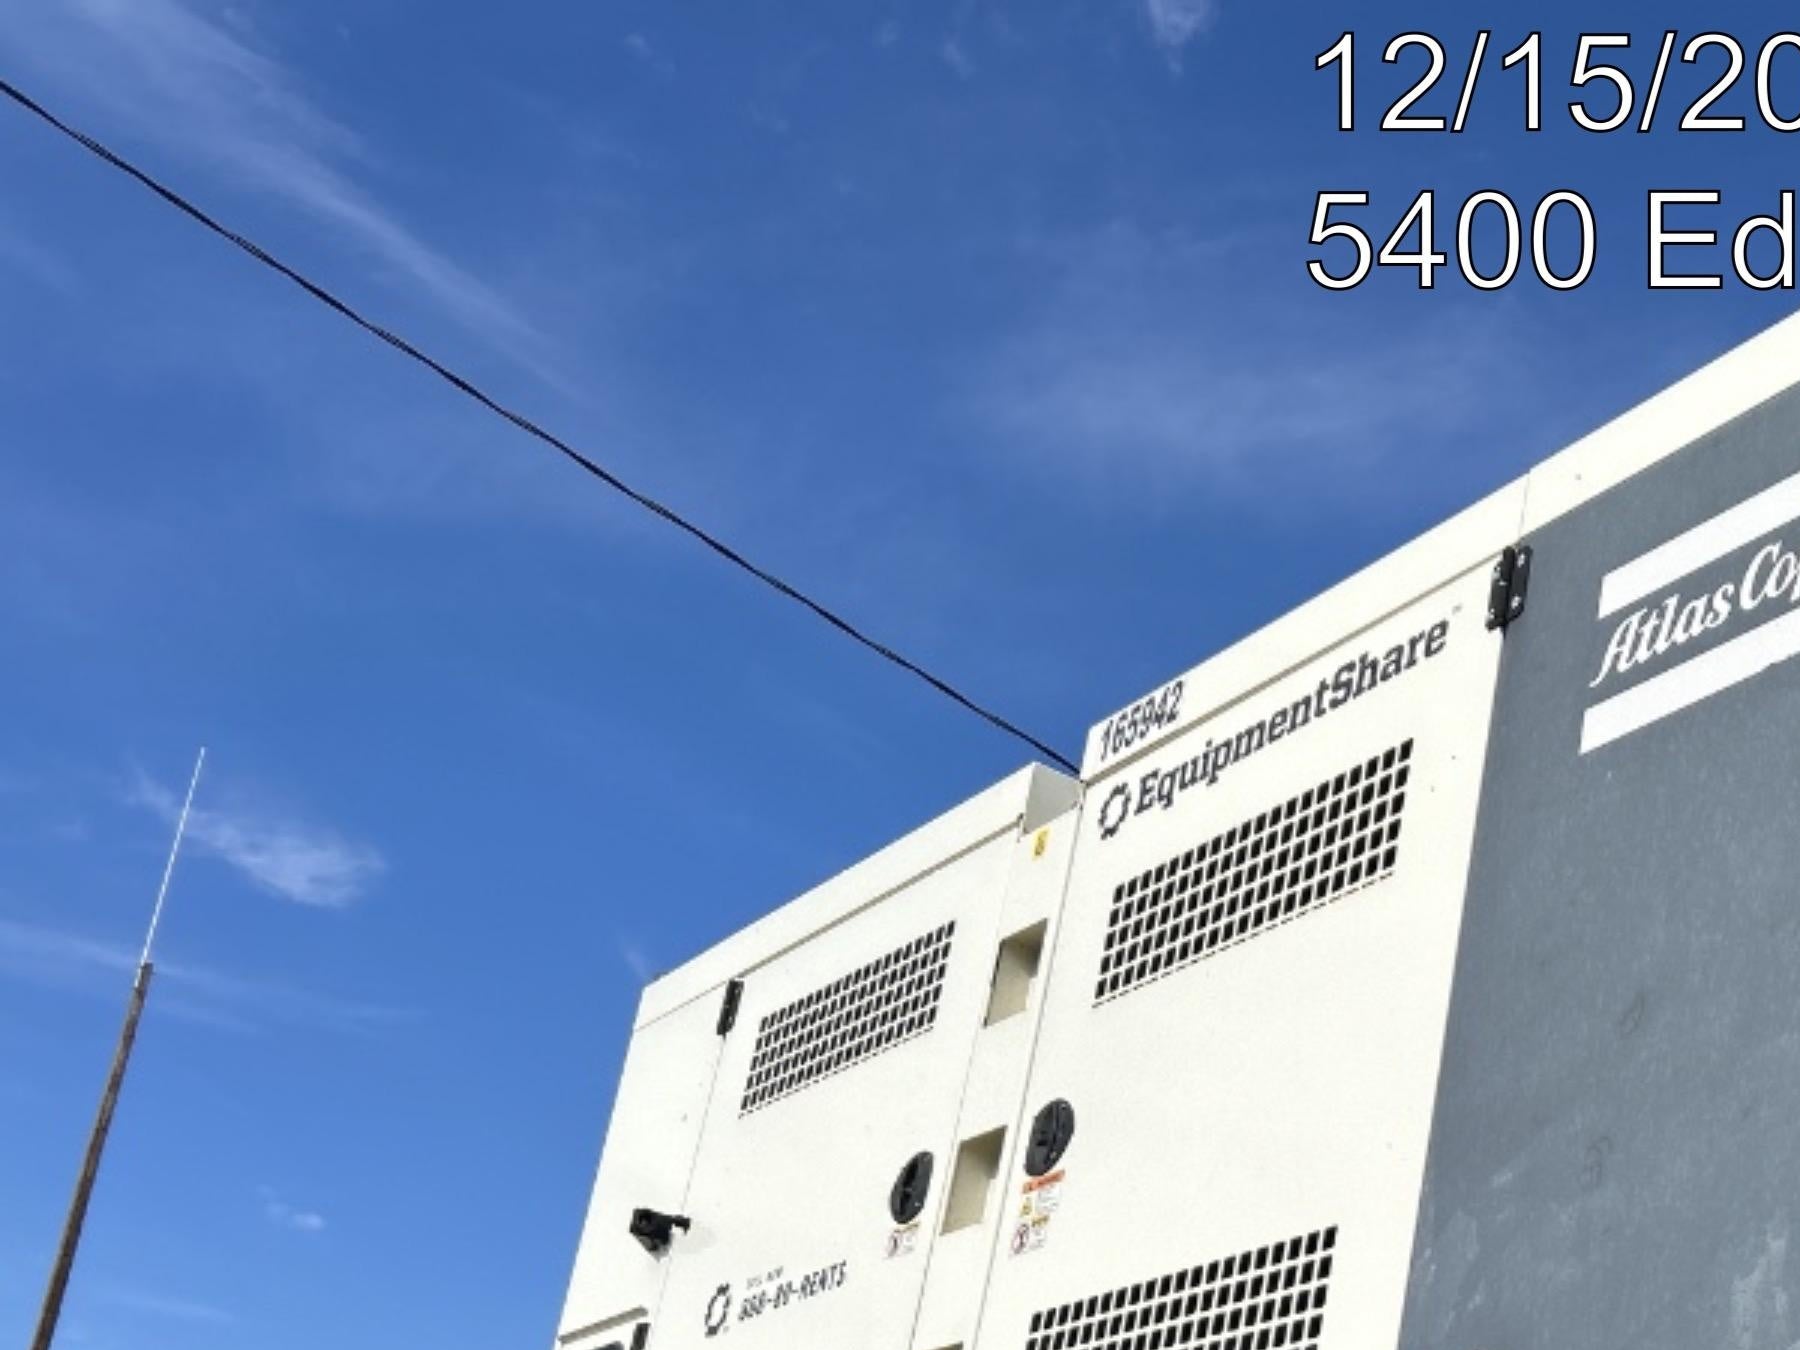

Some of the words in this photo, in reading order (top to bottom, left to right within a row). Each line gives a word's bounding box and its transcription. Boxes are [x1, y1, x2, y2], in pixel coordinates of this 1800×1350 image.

[1588, 581, 1735, 688] Atlas
[1101, 680, 1185, 762] 165942
[1134, 618, 1450, 816] EquipmentShare
